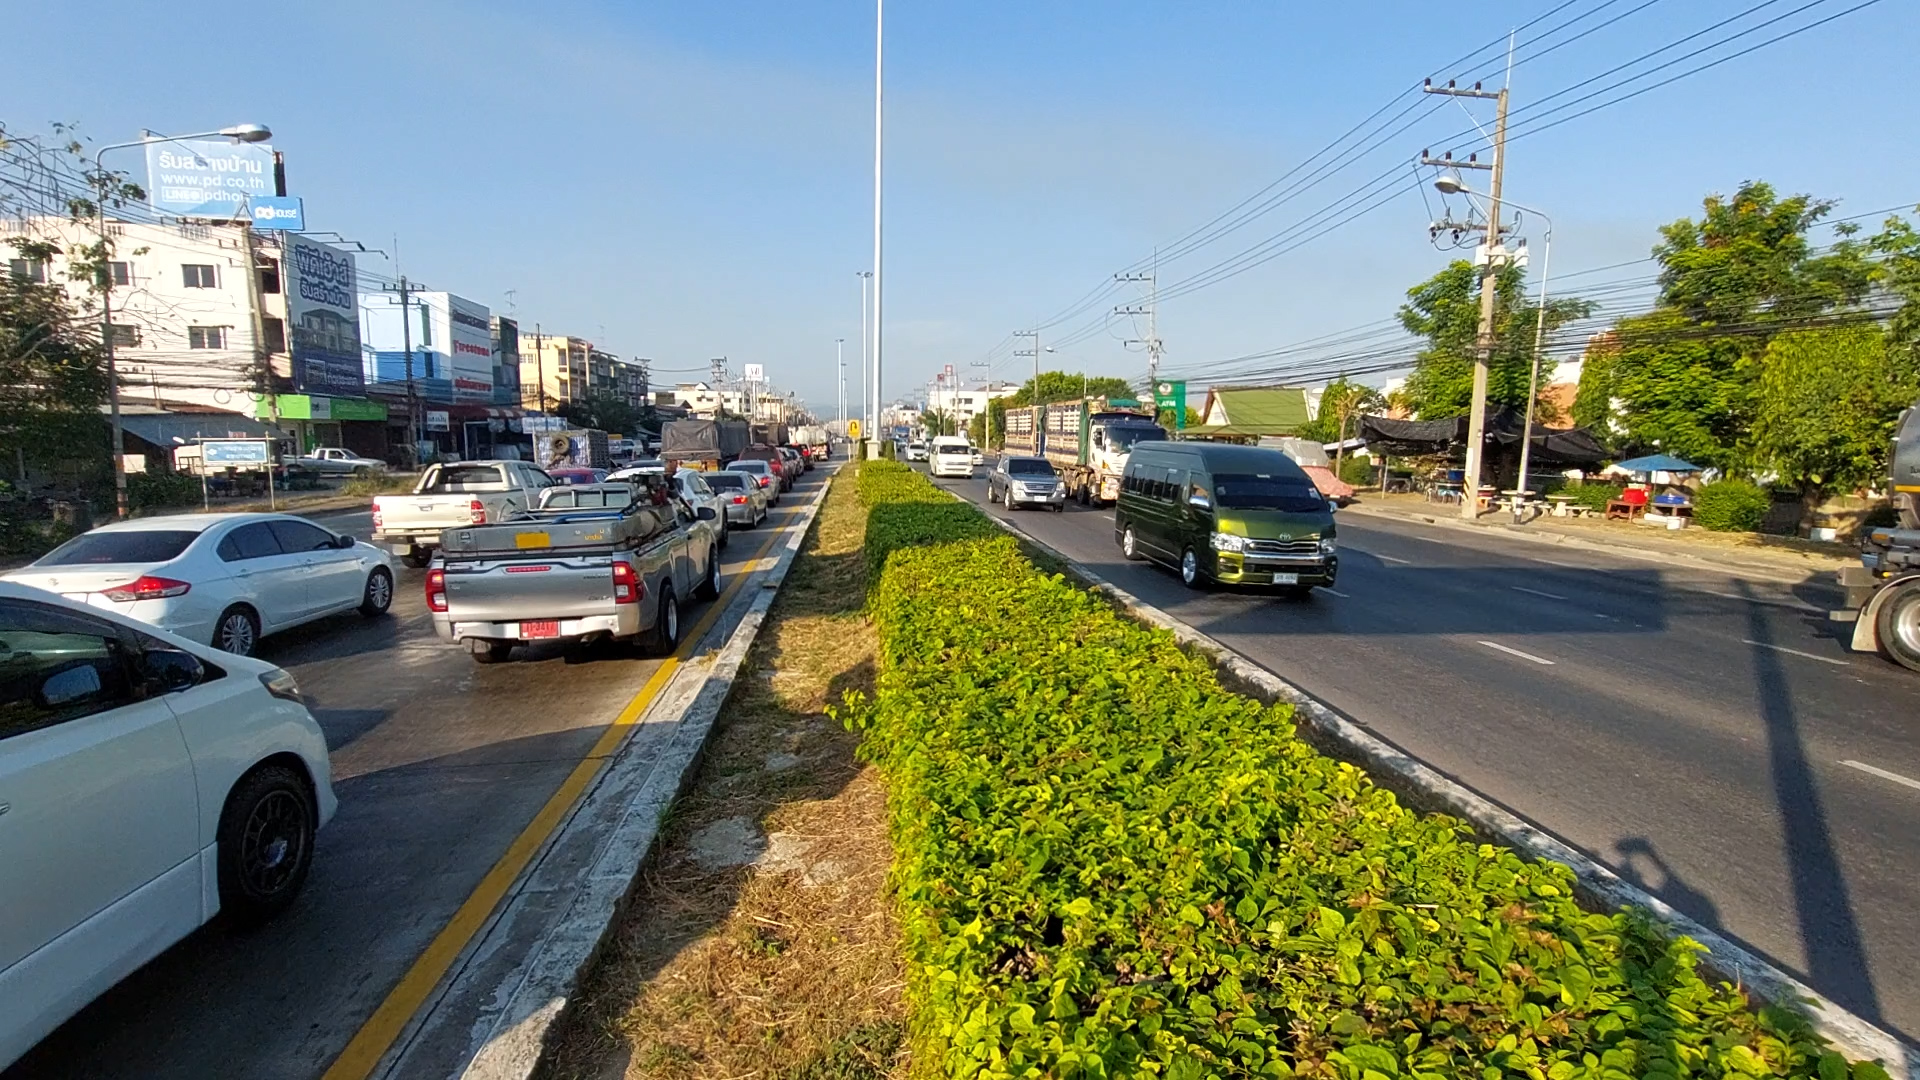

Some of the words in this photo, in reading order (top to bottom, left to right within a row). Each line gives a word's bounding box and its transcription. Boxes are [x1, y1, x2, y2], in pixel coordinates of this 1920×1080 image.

[159, 151, 262, 174] รับสางบ้าน
[160, 173, 264, 189] www.pd.co.th
[204, 189, 263, 203] pdho
